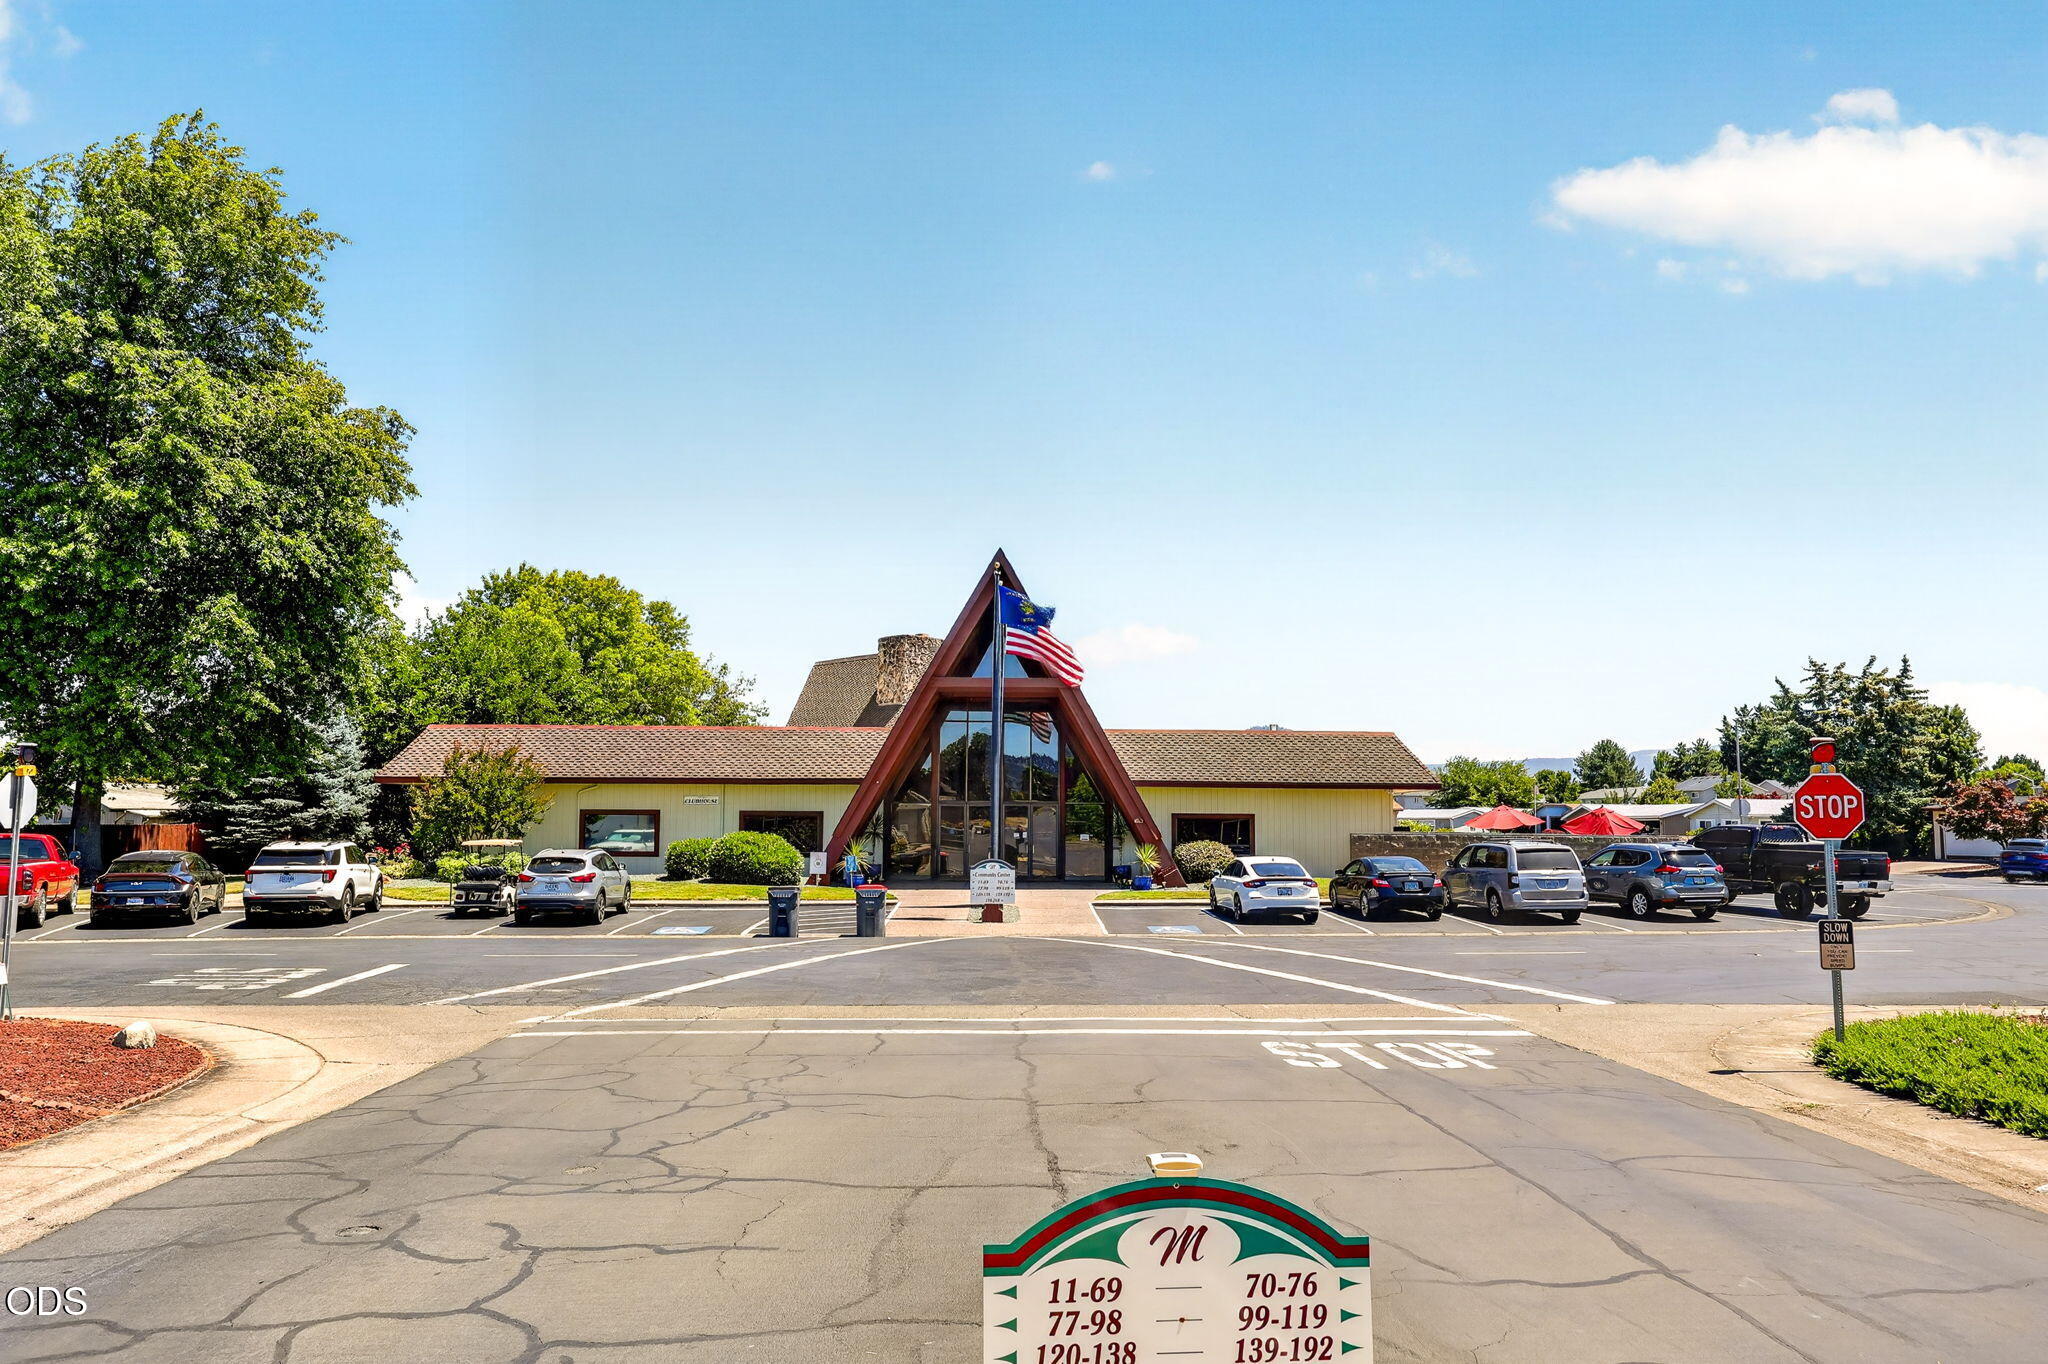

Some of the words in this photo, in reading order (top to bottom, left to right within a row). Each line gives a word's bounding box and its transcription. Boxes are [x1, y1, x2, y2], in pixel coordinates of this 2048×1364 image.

[1800, 794, 1858, 819] STOP
[1823, 922, 1848, 932] SLOW
[1823, 932, 1849, 942] DOWN
[1261, 1042, 1498, 1069] STOP
[1149, 1225, 1209, 1267] M
[1048, 1277, 1123, 1304] 11-69
[1246, 1272, 1318, 1298] 70-76
[1048, 1309, 1123, 1337] 77-98
[1238, 1304, 1328, 1332] 99-119
[1037, 1341, 1137, 1364] 120-138
[1235, 1335, 1334, 1364] 139-192
